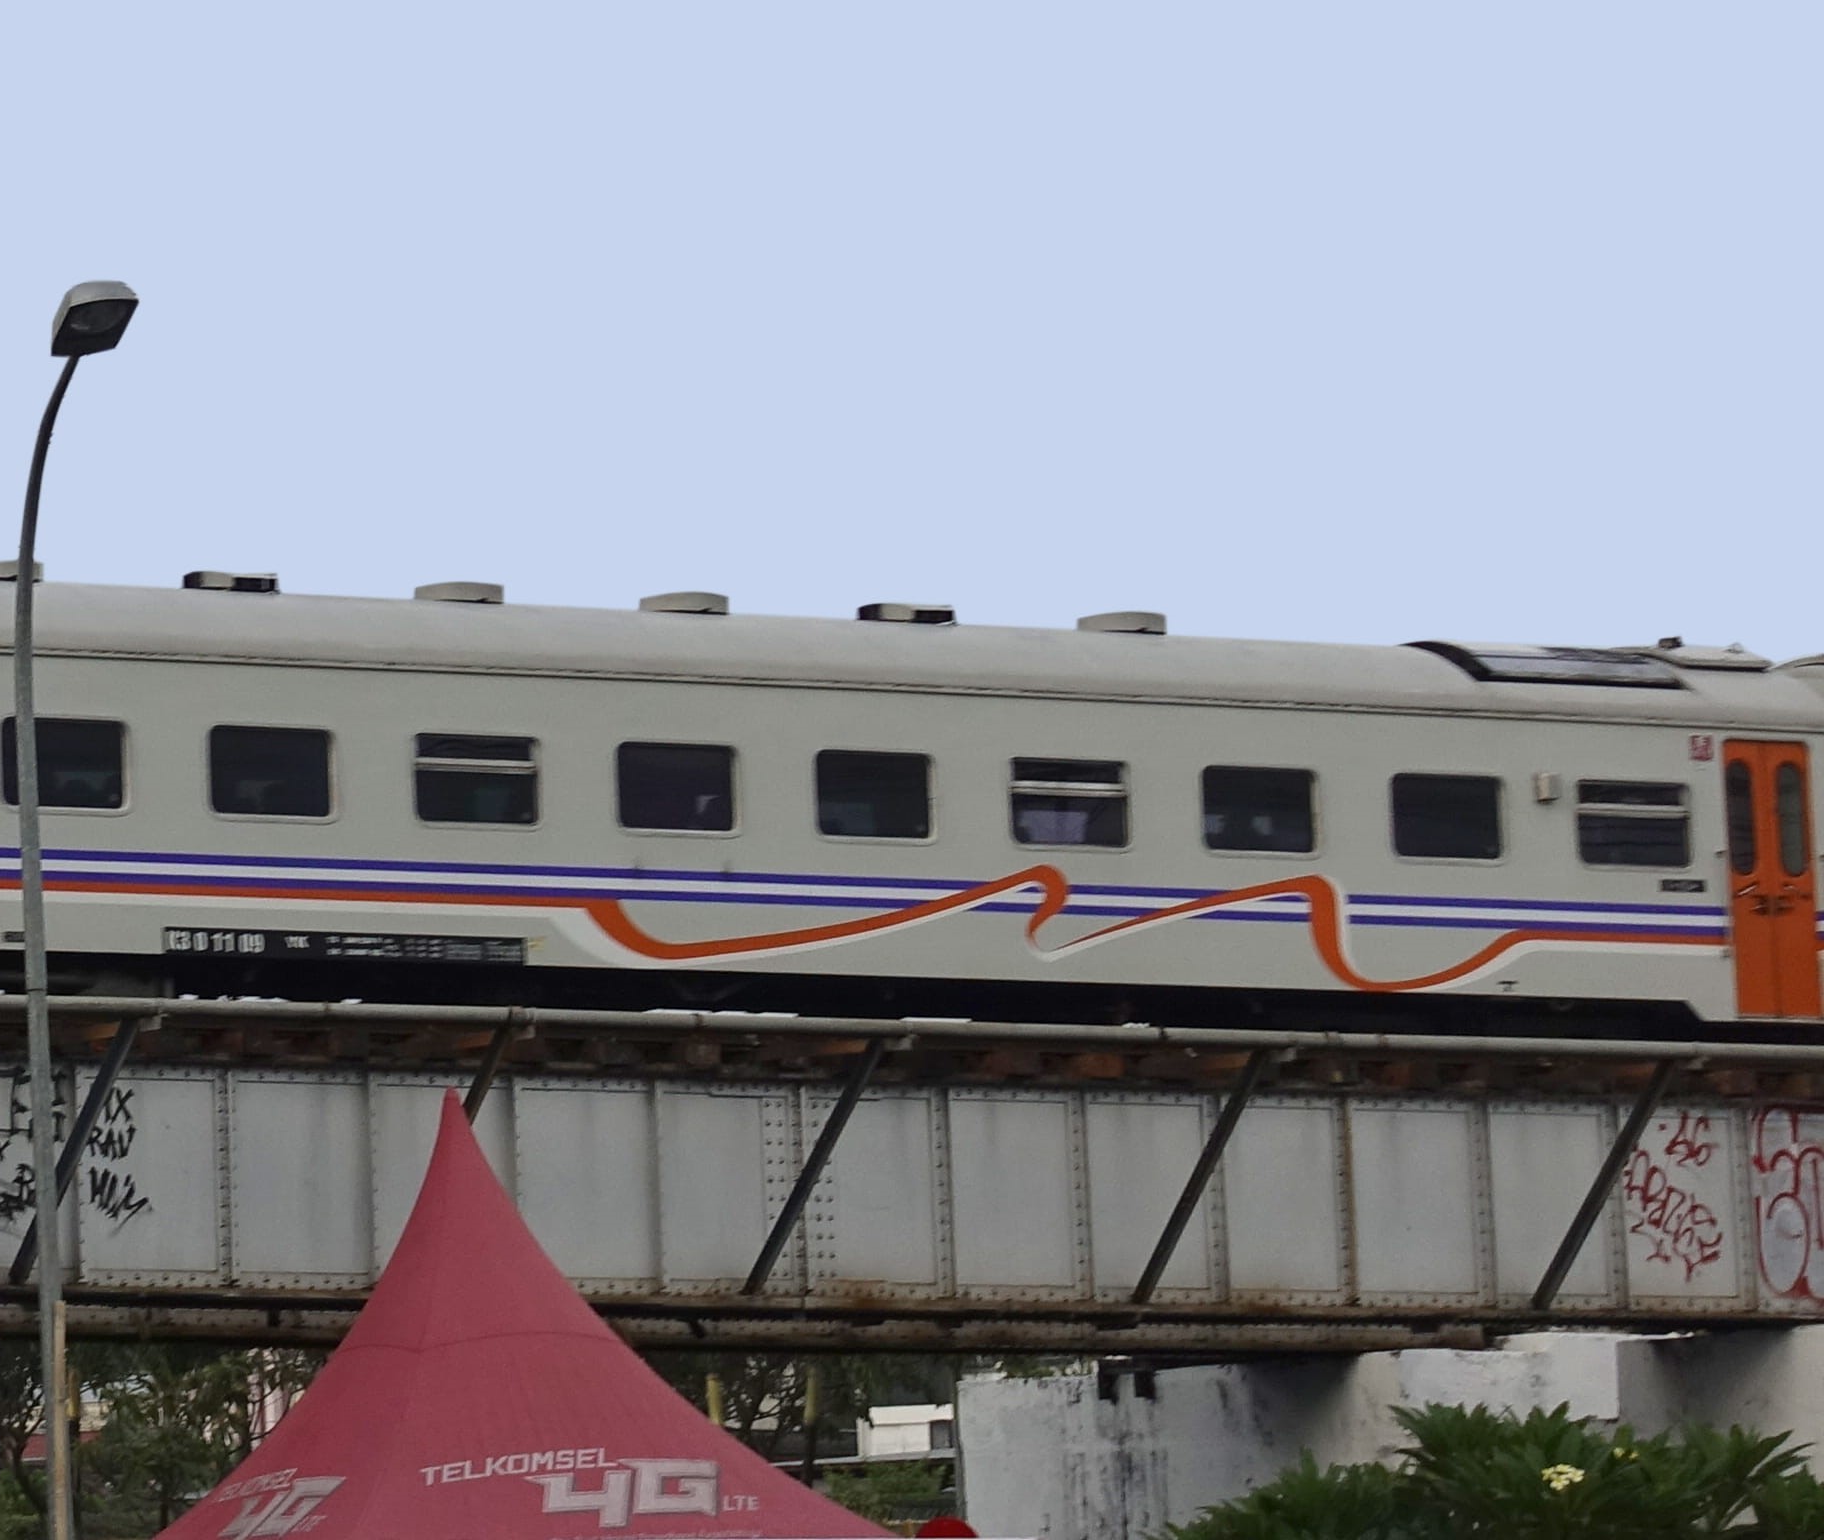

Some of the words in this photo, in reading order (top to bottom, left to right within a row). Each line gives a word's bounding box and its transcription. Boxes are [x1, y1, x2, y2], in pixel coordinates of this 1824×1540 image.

[420, 1447, 619, 1486] TELKOMSEL
[525, 1458, 718, 1528] 4G
[722, 1495, 760, 1512] LTE
